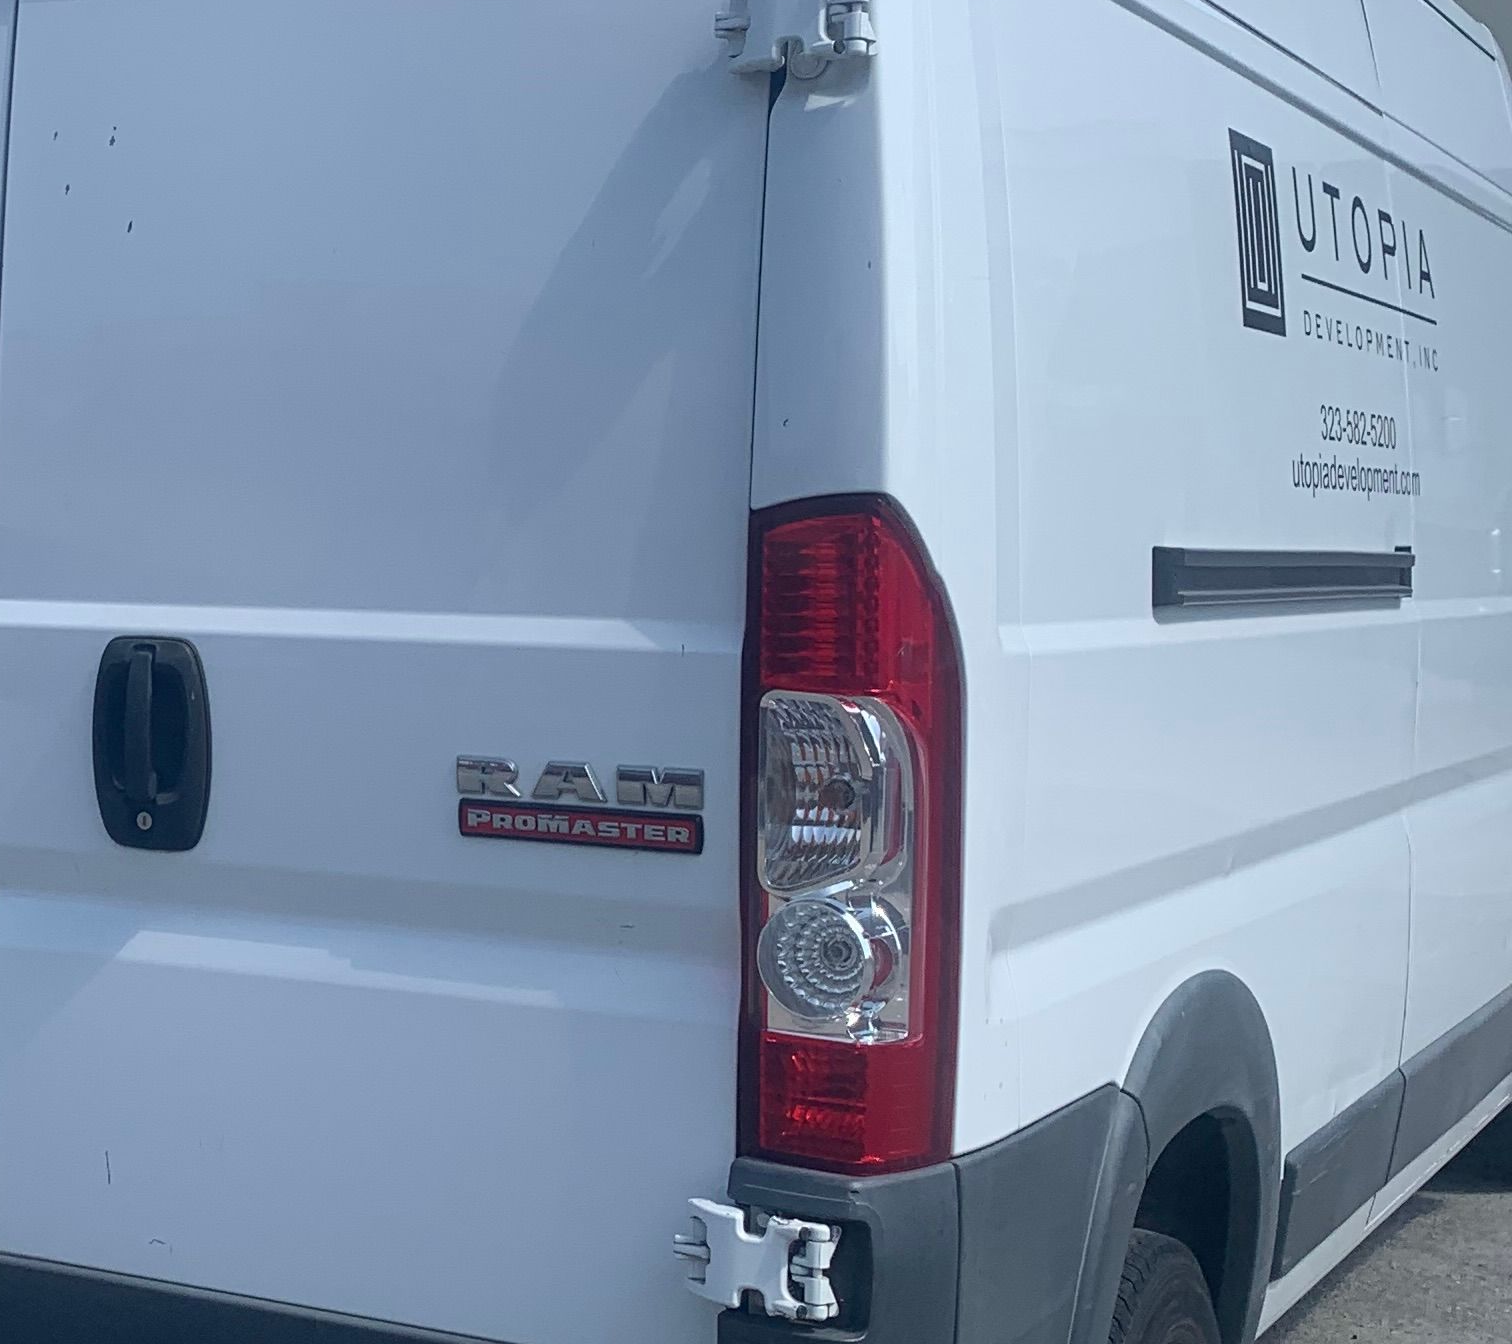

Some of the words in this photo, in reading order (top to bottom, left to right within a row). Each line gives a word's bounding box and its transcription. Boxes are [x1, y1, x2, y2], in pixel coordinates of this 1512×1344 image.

[1292, 166, 1435, 299] UTOPIA
[1320, 404, 1397, 450] 323-582-5200
[1292, 453, 1421, 502] utopiadevelopment.com
[456, 755, 705, 810] RAM
[467, 808, 690, 843] PROMASTER
